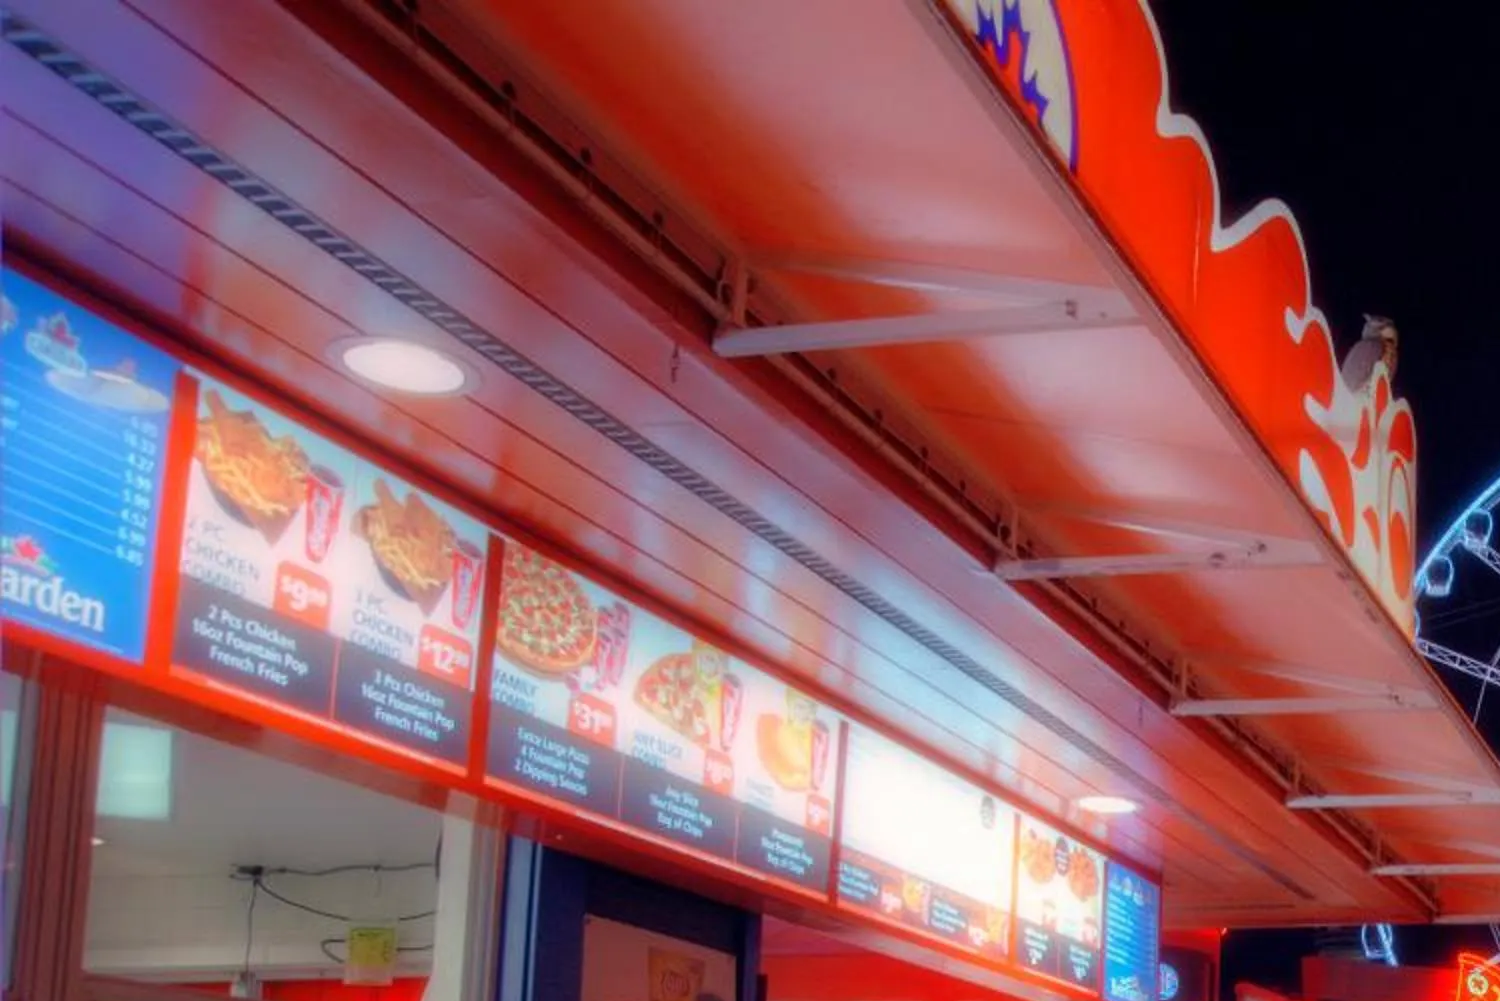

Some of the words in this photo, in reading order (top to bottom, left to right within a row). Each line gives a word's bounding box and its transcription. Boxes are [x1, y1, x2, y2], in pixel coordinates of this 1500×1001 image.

[186, 537, 260, 581] CHICKEN
[208, 604, 217, 620] 2
[245, 620, 296, 651] Chicken
[208, 644, 255, 674] French
[257, 661, 289, 687] Fries
[225, 631, 282, 667] Fountain
[284, 652, 309, 676] Pop
[374, 706, 411, 731] French
[413, 719, 440, 743] Fries
